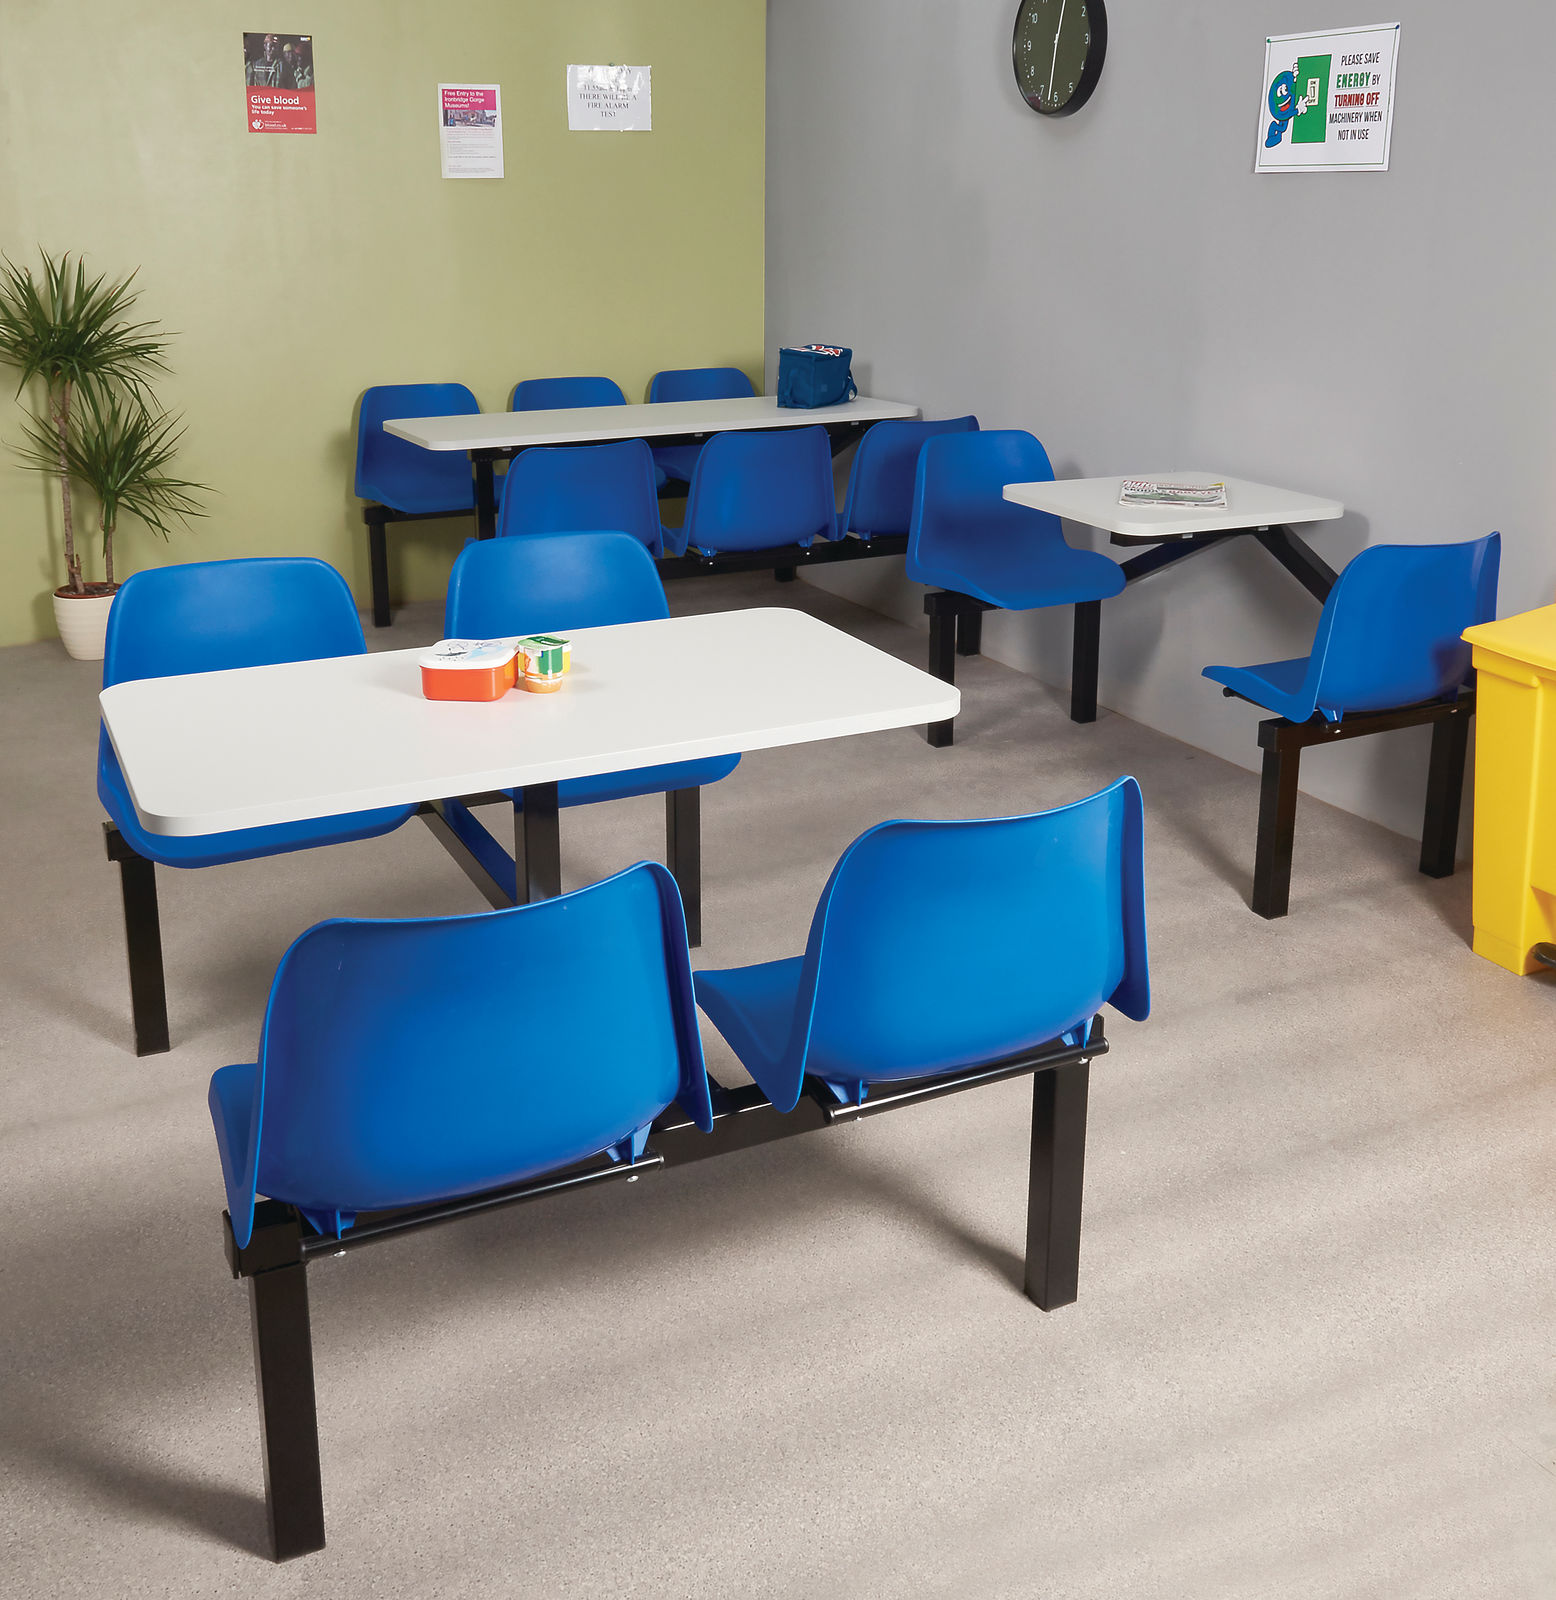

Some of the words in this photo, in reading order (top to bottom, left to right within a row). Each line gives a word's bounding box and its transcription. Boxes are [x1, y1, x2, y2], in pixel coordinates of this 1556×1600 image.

[1081, 6, 1086, 17] 2
[1031, 13, 1038, 24] 10
[1084, 34, 1089, 44] 3
[1026, 40, 1032, 51] 9
[1340, 54, 1363, 66] PLEASE
[1364, 52, 1380, 64] SAVE
[1030, 66, 1035, 76] 8
[1336, 72, 1371, 88] ENERGY
[1372, 74, 1381, 86] BY
[1040, 85, 1045, 95] 7
[1068, 82, 1073, 93] 5
[251, 95, 271, 104] Give
[274, 96, 299, 104] blood
[1054, 92, 1058, 102] 6
[1334, 94, 1364, 107] TURNING
[1366, 92, 1380, 106] OFF
[1328, 112, 1364, 124] MACHINERY
[1364, 110, 1382, 122] WHEN
[1338, 129, 1350, 140] NOT
[1350, 129, 1356, 140] IN
[1357, 128, 1370, 140] USE
